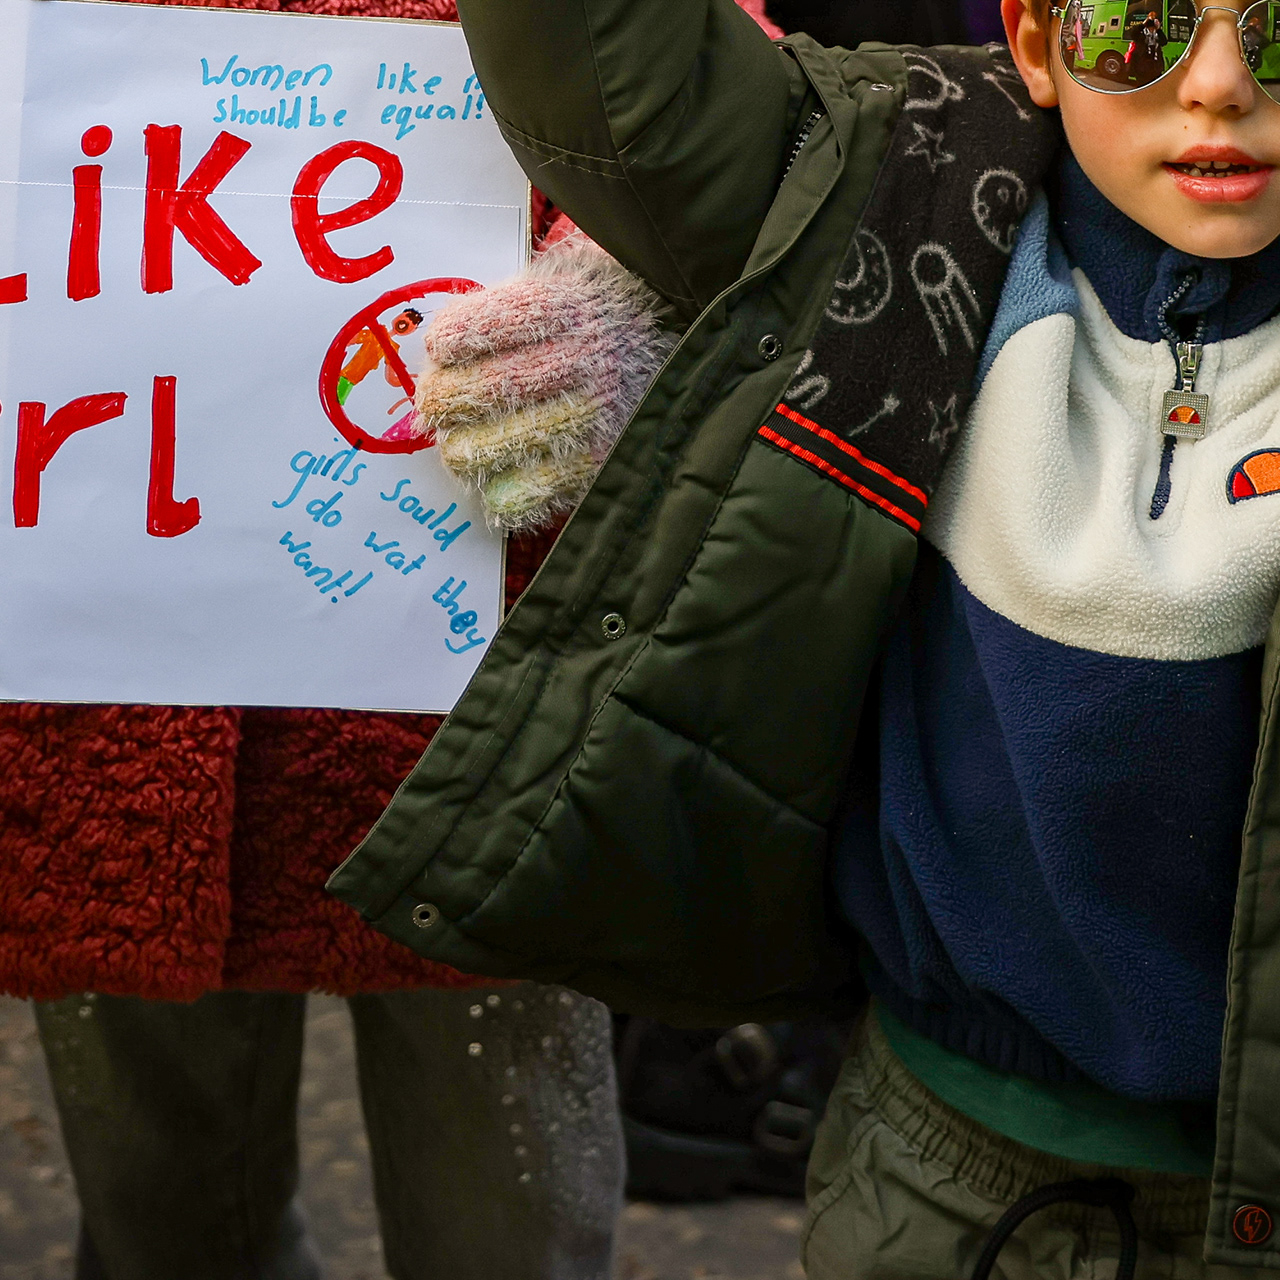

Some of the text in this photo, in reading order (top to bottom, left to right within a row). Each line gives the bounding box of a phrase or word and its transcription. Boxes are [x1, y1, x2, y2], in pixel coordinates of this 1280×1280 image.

[201, 55, 332, 90] Women
[377, 63, 442, 95] like
[309, 96, 347, 127] be
[381, 93, 486, 140] equal!
[272, 438, 470, 551] girls sould
[279, 531, 373, 603] want!
[310, 491, 342, 527] do
[364, 531, 426, 575] wat
